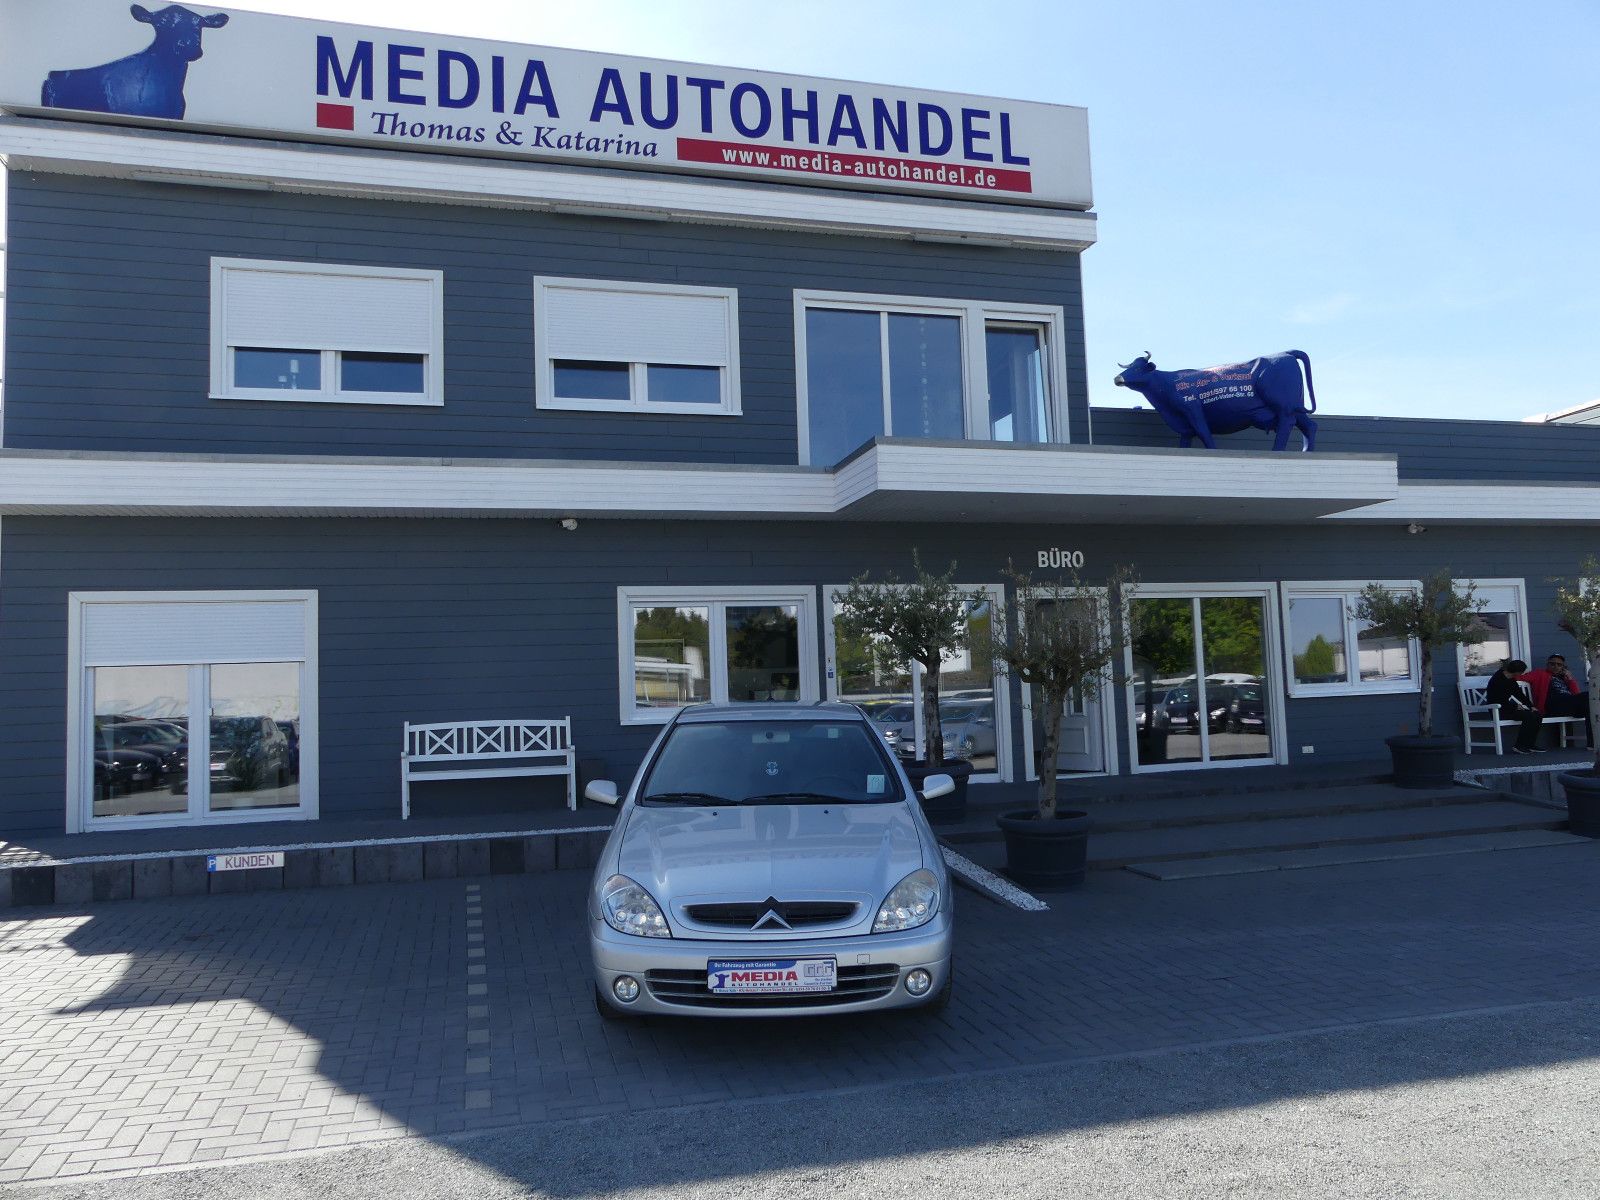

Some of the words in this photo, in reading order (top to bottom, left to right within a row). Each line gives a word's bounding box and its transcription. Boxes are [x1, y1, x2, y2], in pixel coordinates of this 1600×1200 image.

[316, 35, 560, 119] MEDIA
[589, 67, 1031, 167] AUTOHANDEL
[370, 111, 486, 143] Thomas
[495, 120, 523, 146] &
[531, 125, 659, 158] Katarina
[721, 147, 997, 188] www.media-autohandel.de
[1037, 547, 1084, 568] BÜRO
[225, 854, 275, 869] KUNDEN
[731, 970, 798, 982] MEDIA
